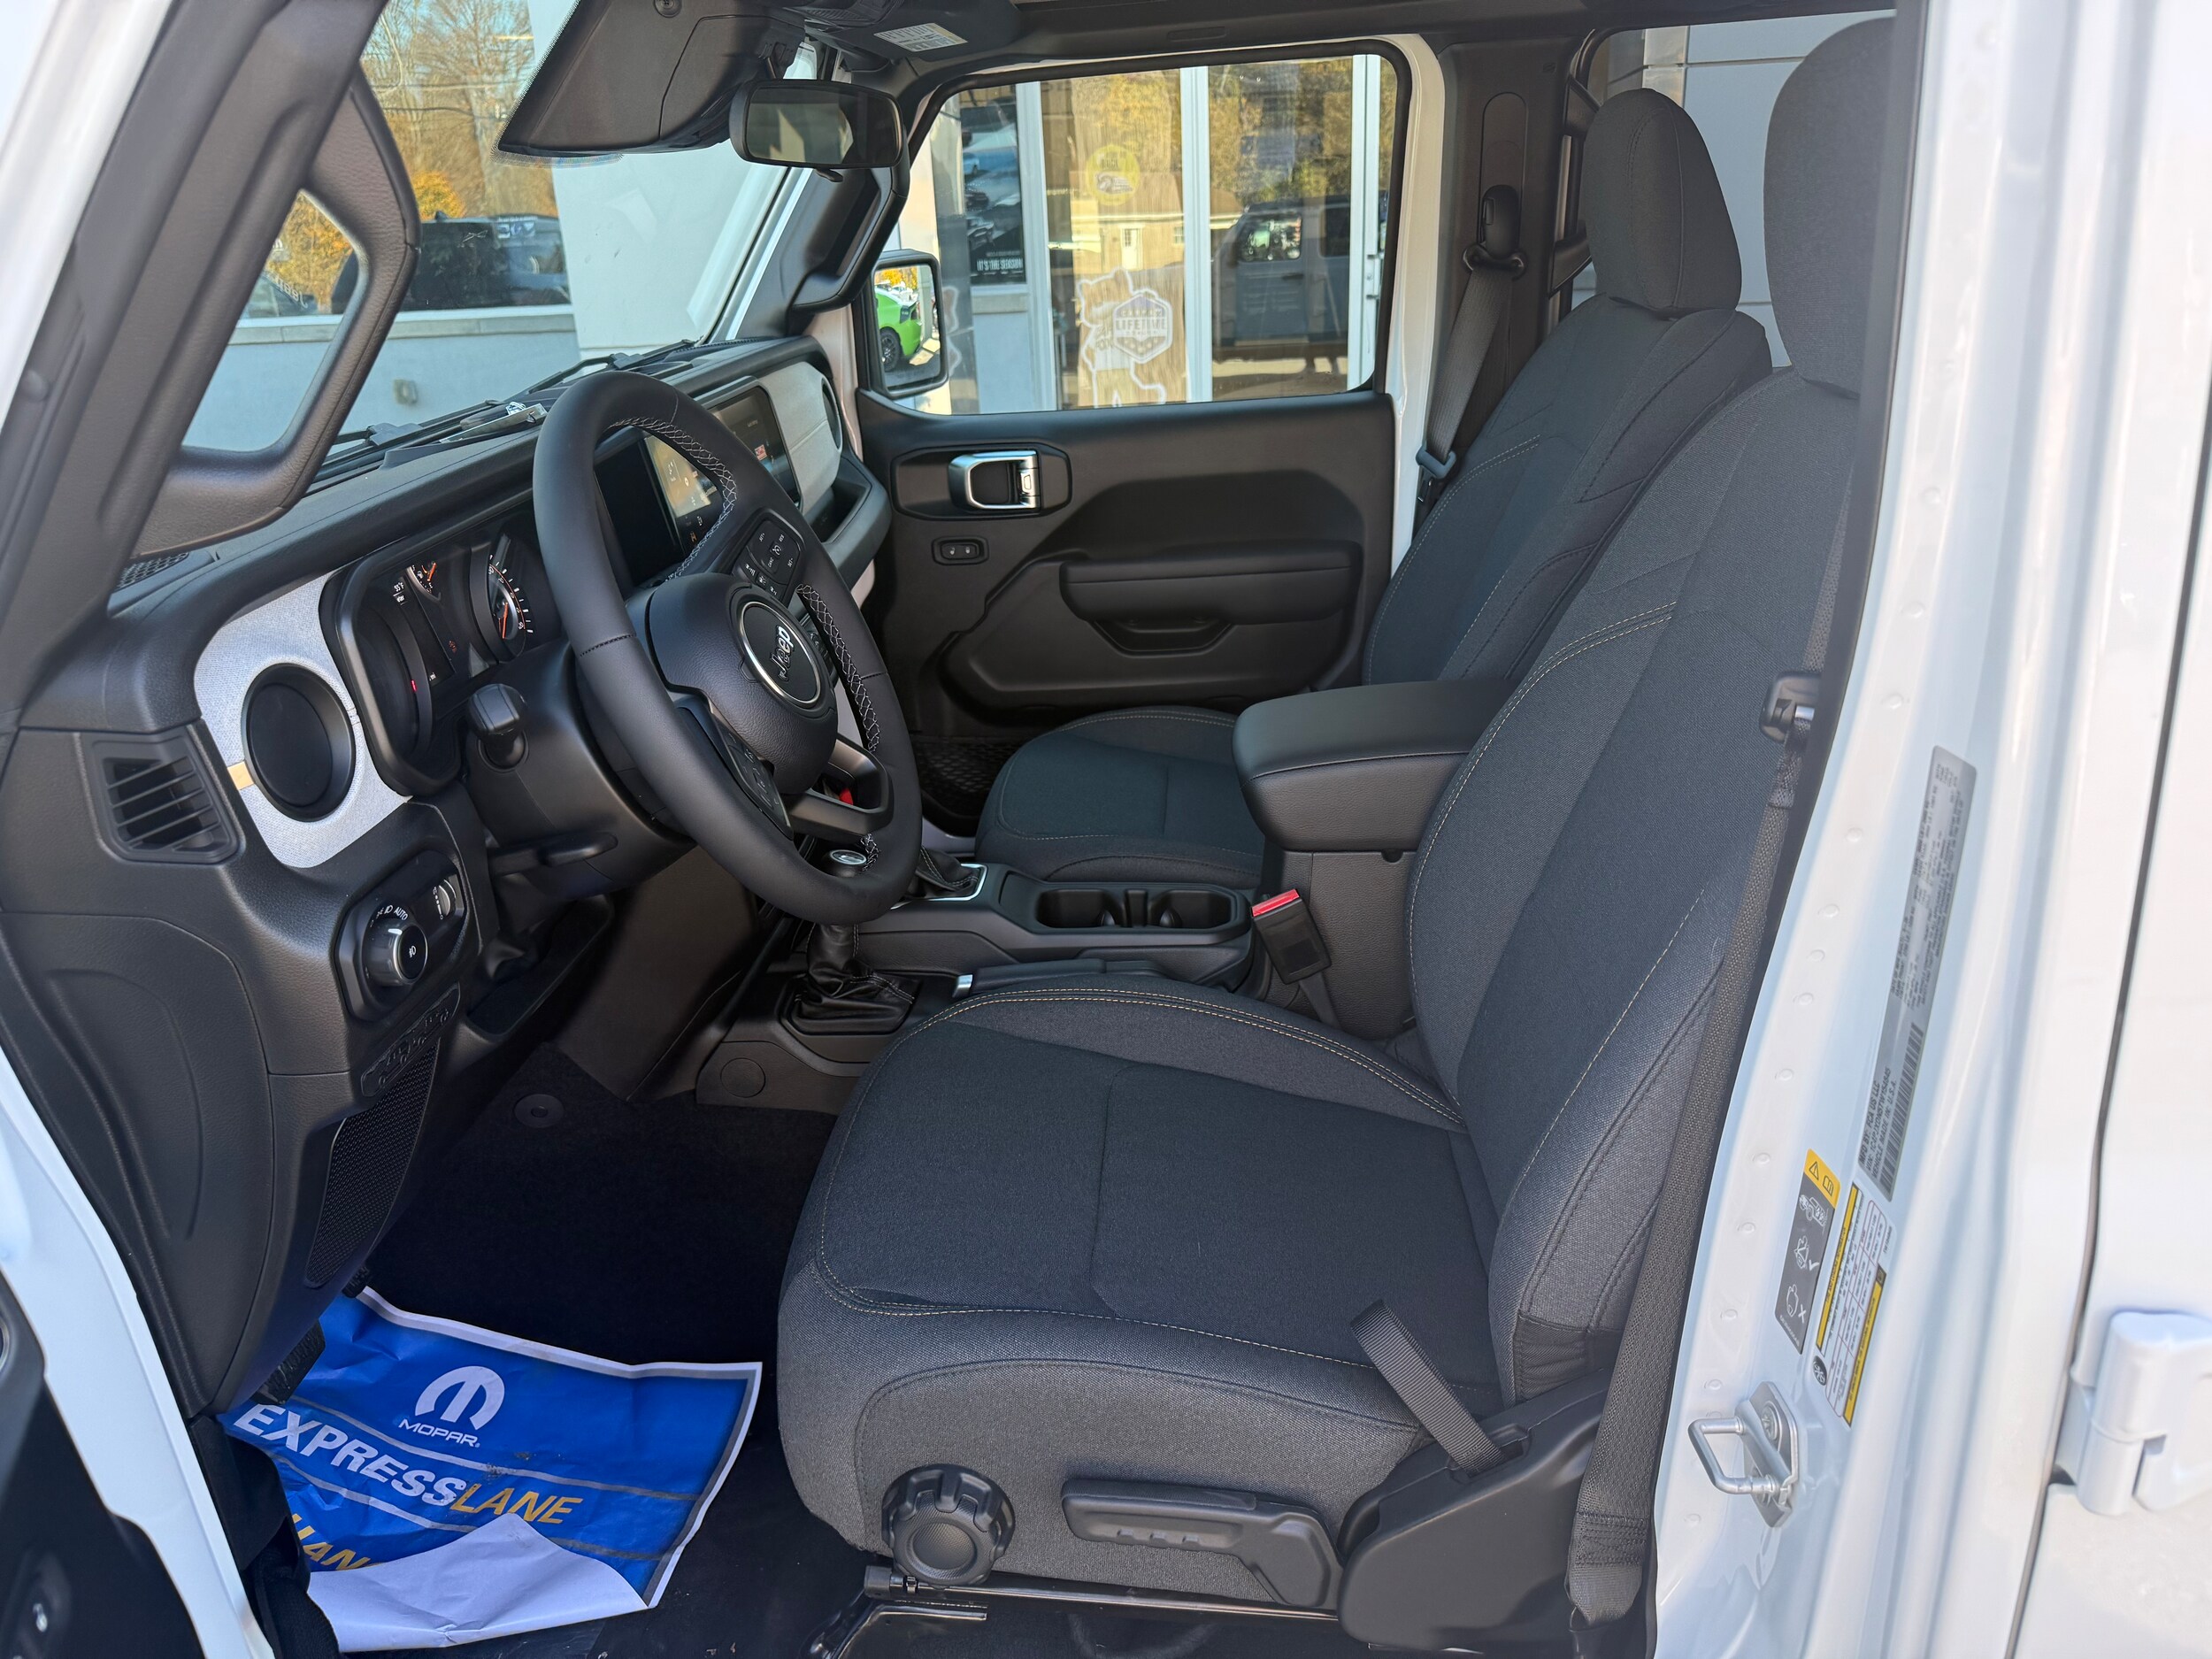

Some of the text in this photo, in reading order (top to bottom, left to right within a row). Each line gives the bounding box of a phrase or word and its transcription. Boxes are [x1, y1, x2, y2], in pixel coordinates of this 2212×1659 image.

[772, 626, 794, 680] Jeep
[393, 906, 408, 920] AUTO
[1871, 1144, 1884, 1179] VEHICLE
[398, 1418, 478, 1447] MOPAR
